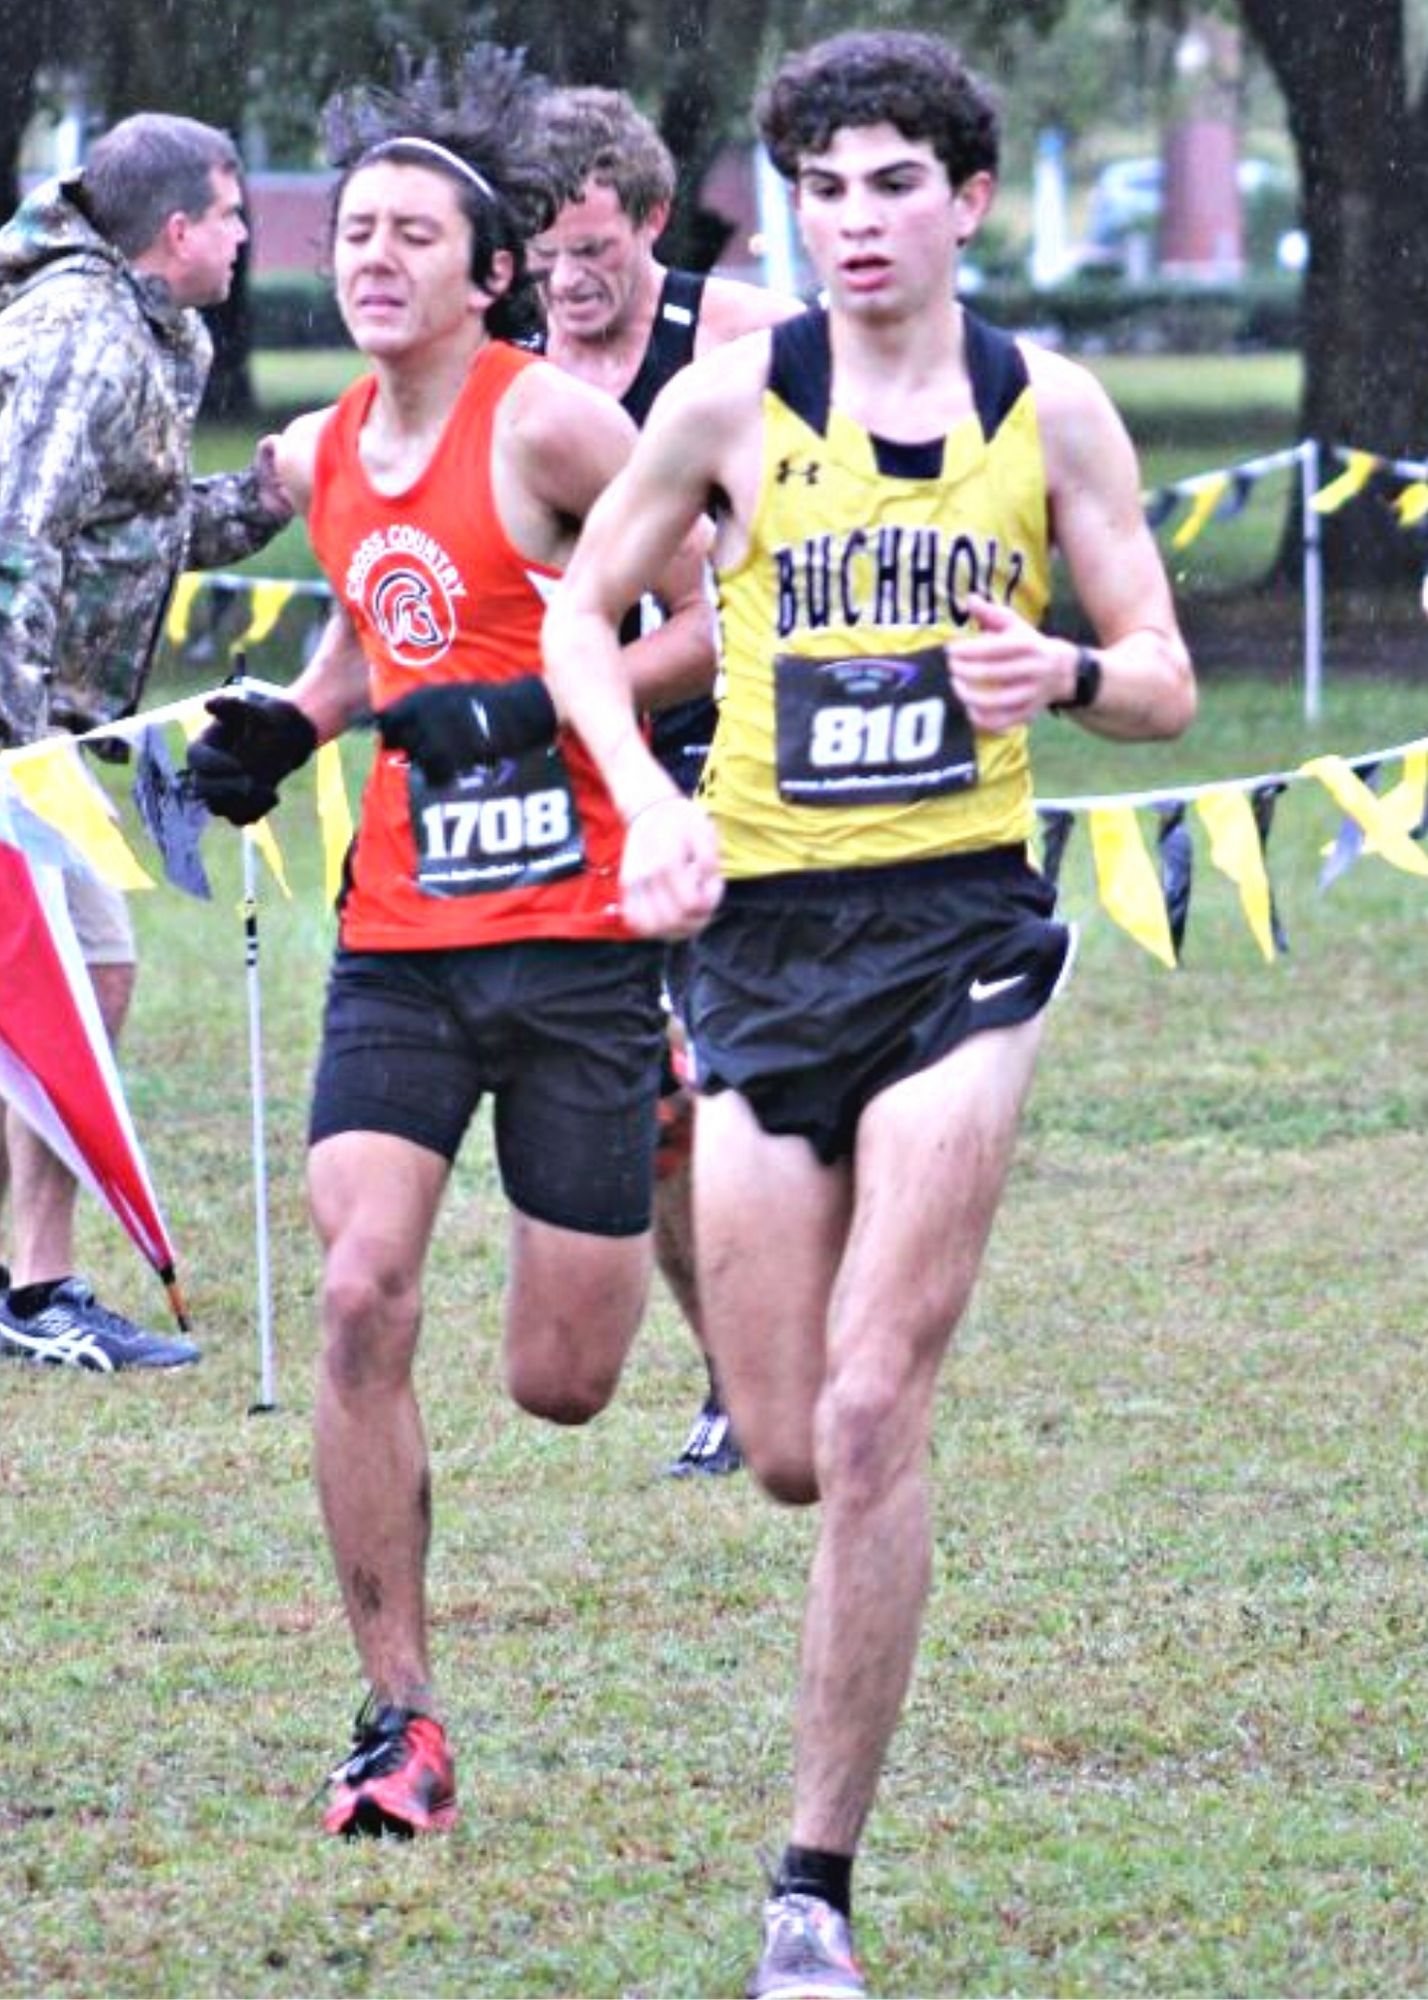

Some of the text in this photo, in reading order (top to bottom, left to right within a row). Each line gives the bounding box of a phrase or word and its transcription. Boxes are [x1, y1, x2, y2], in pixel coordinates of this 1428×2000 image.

[346, 524, 466, 600] CROSS COUNTRY
[810, 698, 945, 767] 810
[422, 788, 569, 858] 1708
